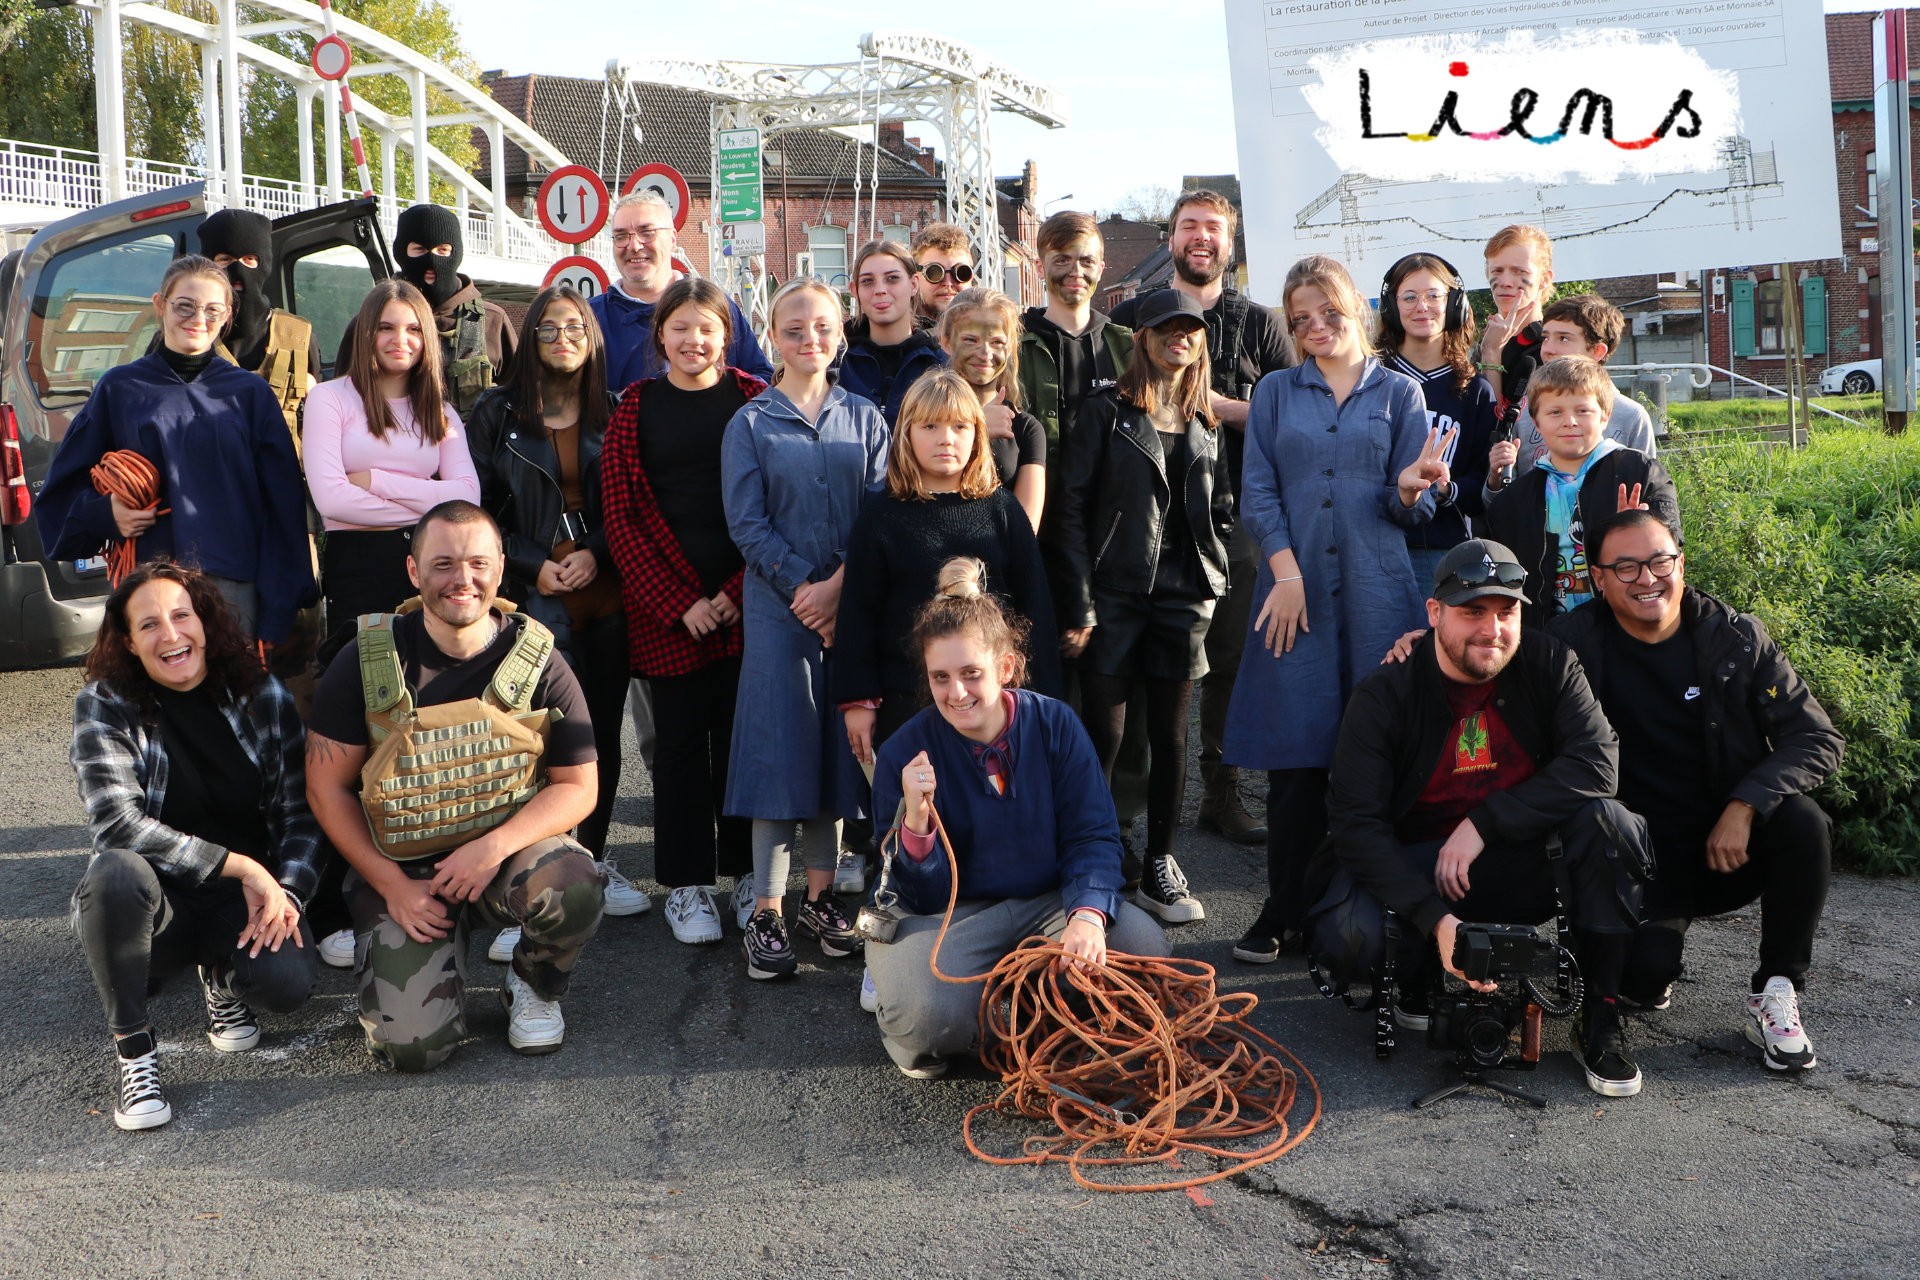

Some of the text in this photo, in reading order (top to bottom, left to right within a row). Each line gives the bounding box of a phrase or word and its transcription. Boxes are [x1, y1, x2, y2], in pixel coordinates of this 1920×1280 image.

[1270, 6, 1282, 16] La
[1285, 0, 1352, 15] restauration
[1364, 19, 1390, 28] Auteur
[1404, 14, 1427, 25] Projet
[1434, 10, 1469, 20] Direction
[1471, 8, 1485, 16] des
[1486, 6, 1508, 14] Voies
[1509, 0, 1560, 13] hydrauliques
[1576, 14, 1617, 26] Entreprise
[1618, 9, 1670, 21] adjudicataire
[1676, 6, 1702, 16] Wanty
[1482, 24, 1509, 36] Arcade
[1688, 26, 1702, 35] 100
[1704, 25, 1724, 35] jours
[1726, 20, 1766, 31] ouvrables
[1274, 46, 1324, 58] Coordination
[729, 152, 752, 160] Louvière
[724, 226, 734, 239] 4
